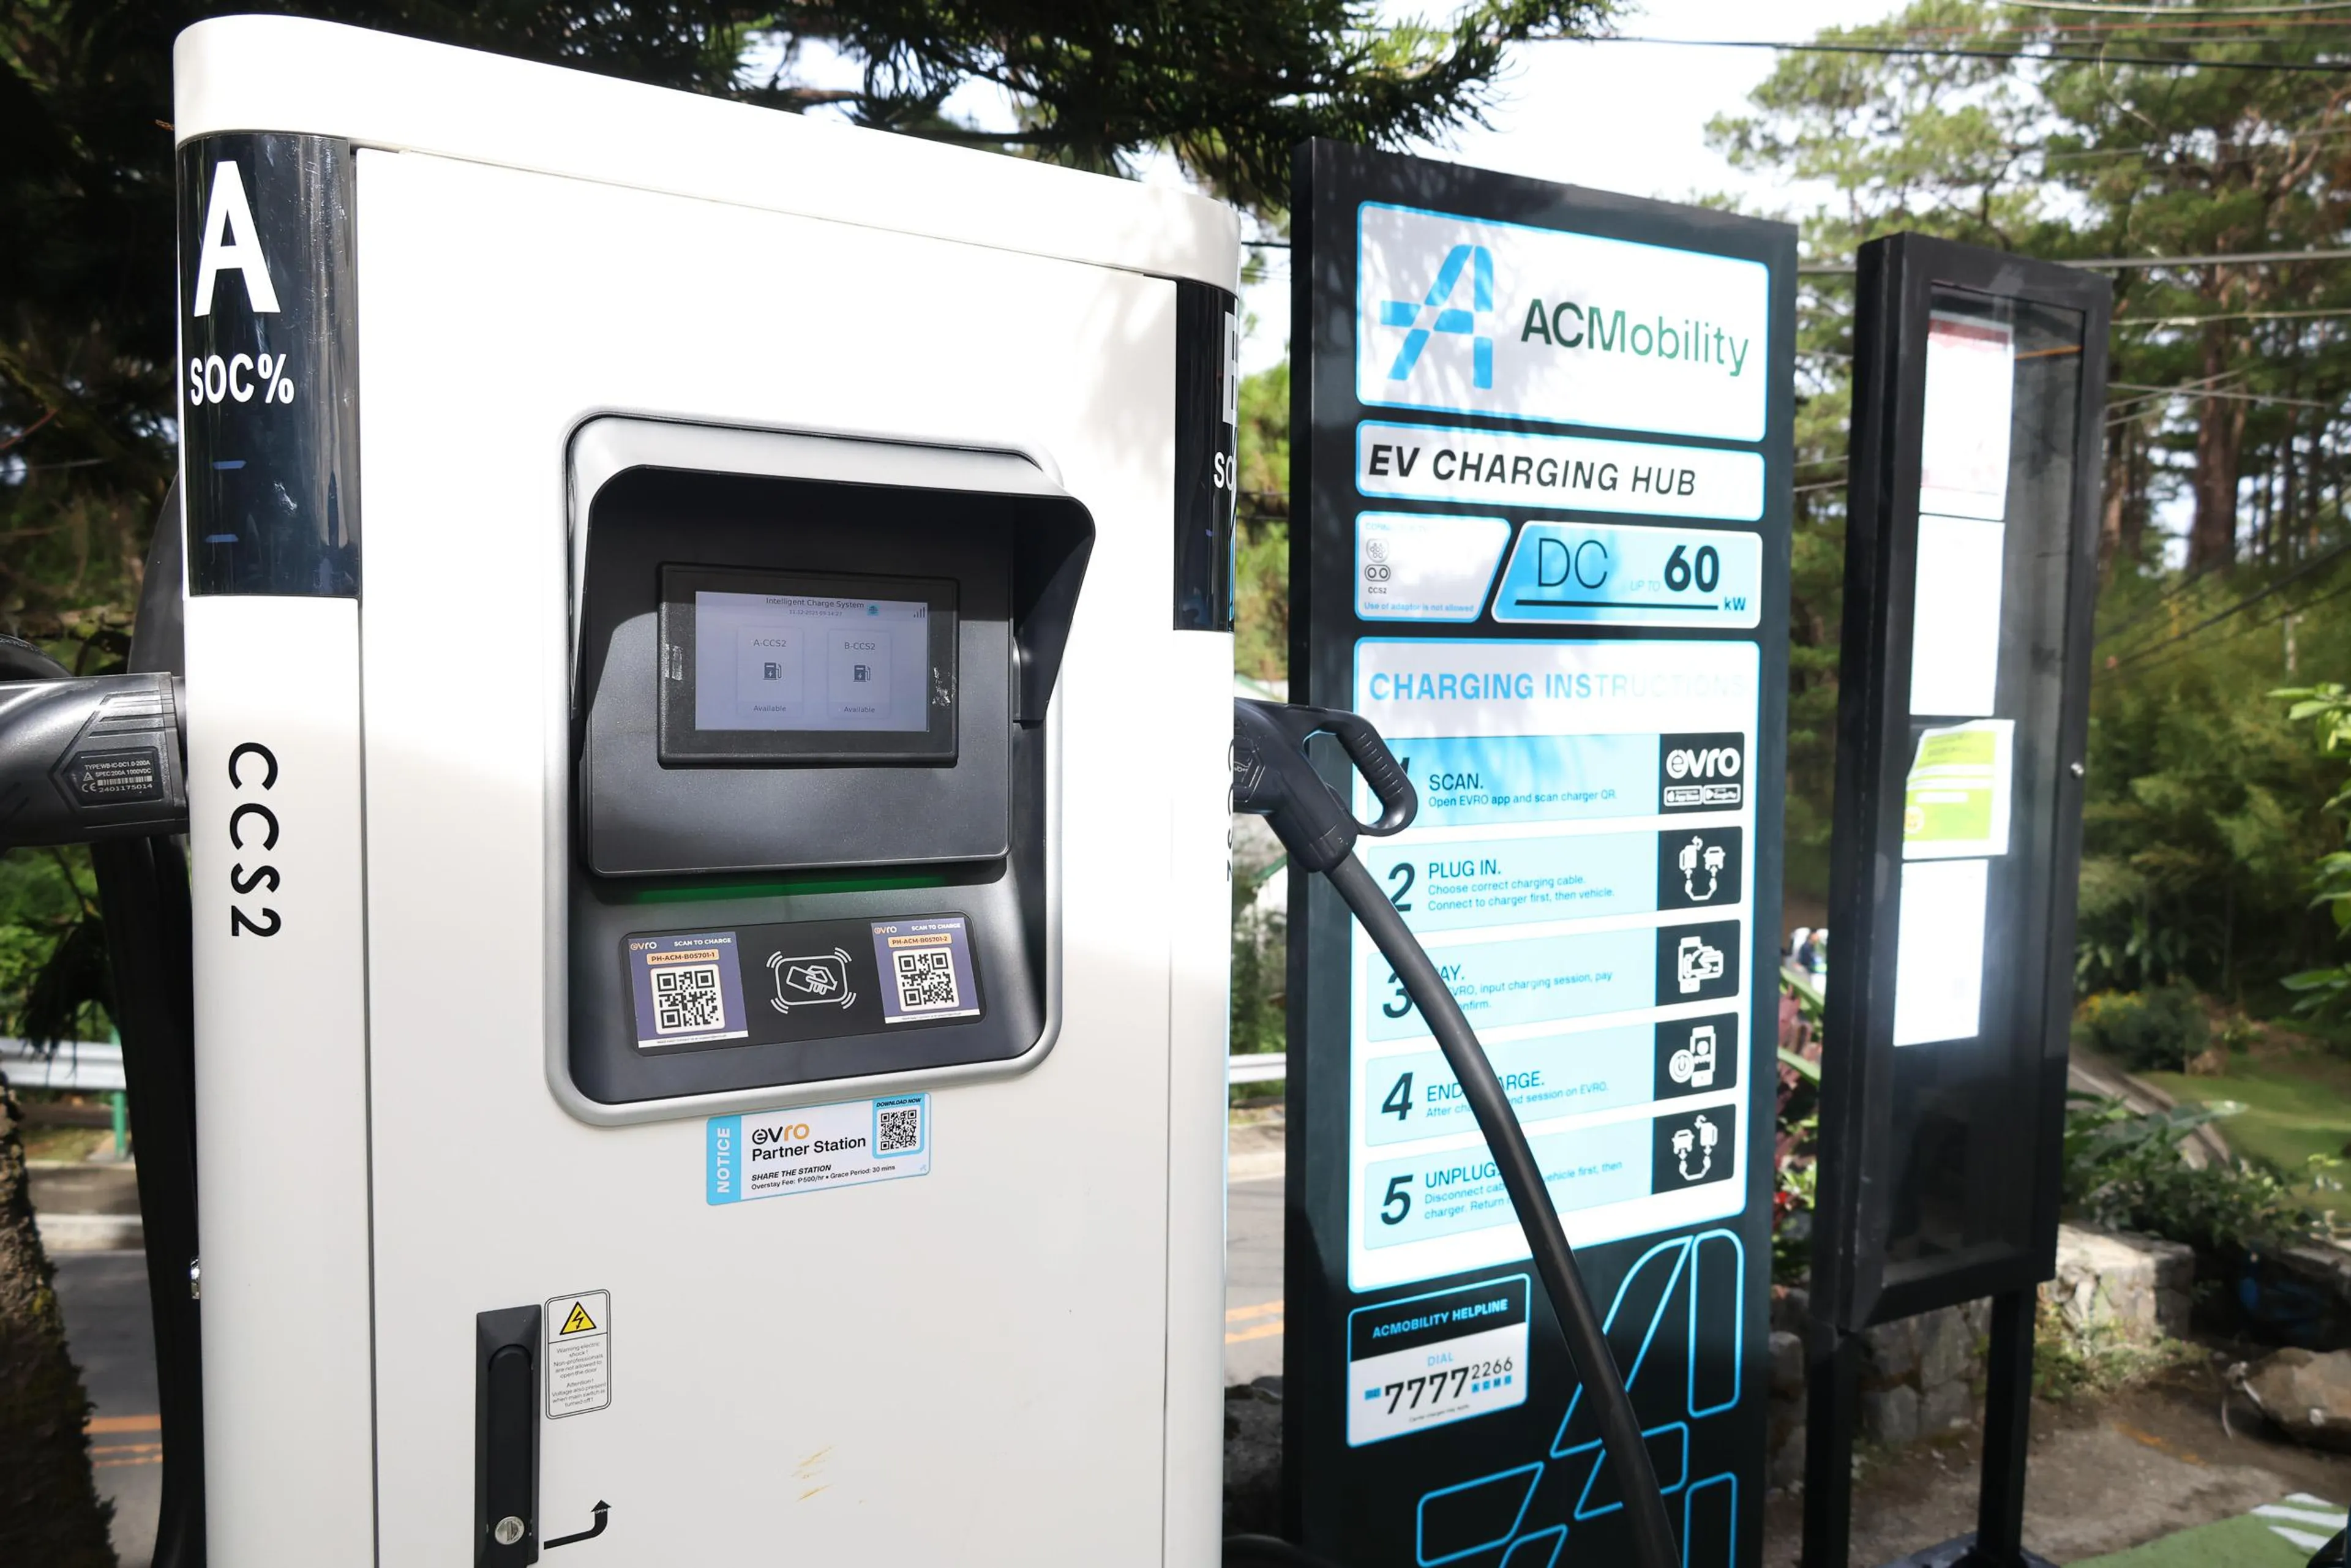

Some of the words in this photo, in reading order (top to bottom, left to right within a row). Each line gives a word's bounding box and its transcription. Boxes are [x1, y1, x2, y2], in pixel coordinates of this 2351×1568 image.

[194, 160, 281, 317] A
[1521, 298, 1749, 377] ACMobility
[190, 353, 295, 406] SOC%
[1368, 445, 1419, 477] EV
[1433, 449, 1618, 491] CHARGING
[1632, 466, 1697, 496] HUB
[1538, 538, 1608, 590] DC
[1664, 545, 1720, 593] 60
[1724, 597, 1746, 611] kW
[1368, 586, 1387, 595] CCS2
[766, 598, 804, 607] Intelligent
[807, 599, 834, 608] Charge
[836, 600, 864, 609] System
[753, 639, 787, 648] A-CCS2
[844, 642, 876, 651] B-CCS2
[1369, 673, 1534, 701] CHARGING
[1666, 747, 1741, 779] evro
[1429, 773, 1483, 791] SCAN.
[1428, 796, 1457, 808] Open
[1459, 795, 1488, 806] EVRO
[1491, 795, 1510, 806] app
[1513, 793, 1532, 803] and
[1534, 793, 1558, 803] scan
[1561, 791, 1598, 803] charger
[228, 742, 281, 937] CCS2
[1428, 860, 1474, 879] PLUG
[1480, 859, 1501, 876] IN.
[1387, 862, 1415, 912] 2
[1428, 883, 1468, 895] Choose
[1471, 881, 1509, 893] correct
[1511, 877, 1554, 890] charging
[1556, 874, 1586, 886] cable.
[1428, 898, 1472, 911] Connect
[1475, 898, 1485, 907] to
[1488, 895, 1527, 907] charger
[1530, 892, 1552, 903] first,
[1554, 891, 1576, 901] then
[1578, 887, 1615, 899] vehicle.
[874, 926, 897, 934] evro
[892, 936, 948, 945] PH-ACM-B05701-2
[630, 941, 658, 951] evro
[651, 952, 715, 962] PH-ACM-B05701-1
[1436, 964, 1465, 981] AY.
[1449, 985, 1477, 996] VRO,
[1480, 981, 1505, 996] input
[1507, 978, 1551, 991] charging
[1553, 973, 1593, 986] session,
[1594, 971, 1613, 982] pay
[1382, 970, 1412, 1019] 3
[1459, 1000, 1491, 1011] nfirm.
[1381, 1071, 1414, 1121] 4
[1427, 1082, 1464, 1102] END
[1498, 1071, 1545, 1090] RGE.
[876, 1099, 907, 1108] DOWNLOAD
[1426, 1106, 1451, 1118] After
[1526, 1091, 1564, 1103] session
[1565, 1089, 1578, 1097] on
[1580, 1081, 1609, 1095] EVRO.
[752, 1123, 810, 1145] evro
[717, 1127, 730, 1193] NOTICE
[752, 1144, 809, 1161] Partner
[814, 1137, 866, 1153] Station
[751, 1171, 779, 1181] SHARE
[781, 1169, 797, 1177] THE
[798, 1165, 831, 1175] STATION
[751, 1180, 781, 1190] Overstay
[850, 1168, 872, 1177] Period:
[1425, 1185, 1484, 1204] Disconnect
[1486, 1182, 1505, 1193] cab
[1578, 1166, 1600, 1177] first,
[1601, 1161, 1623, 1172] then
[1380, 1174, 1414, 1225] 5
[1424, 1205, 1468, 1220] charger.
[1470, 1198, 1504, 1211] Return
[1372, 1311, 1449, 1339] ACMOBILITY
[1452, 1299, 1509, 1321] HELPLINE
[1427, 1352, 1454, 1367] DIAL
[1385, 1365, 1470, 1416] 7777
[1471, 1356, 1513, 1381] 2266
